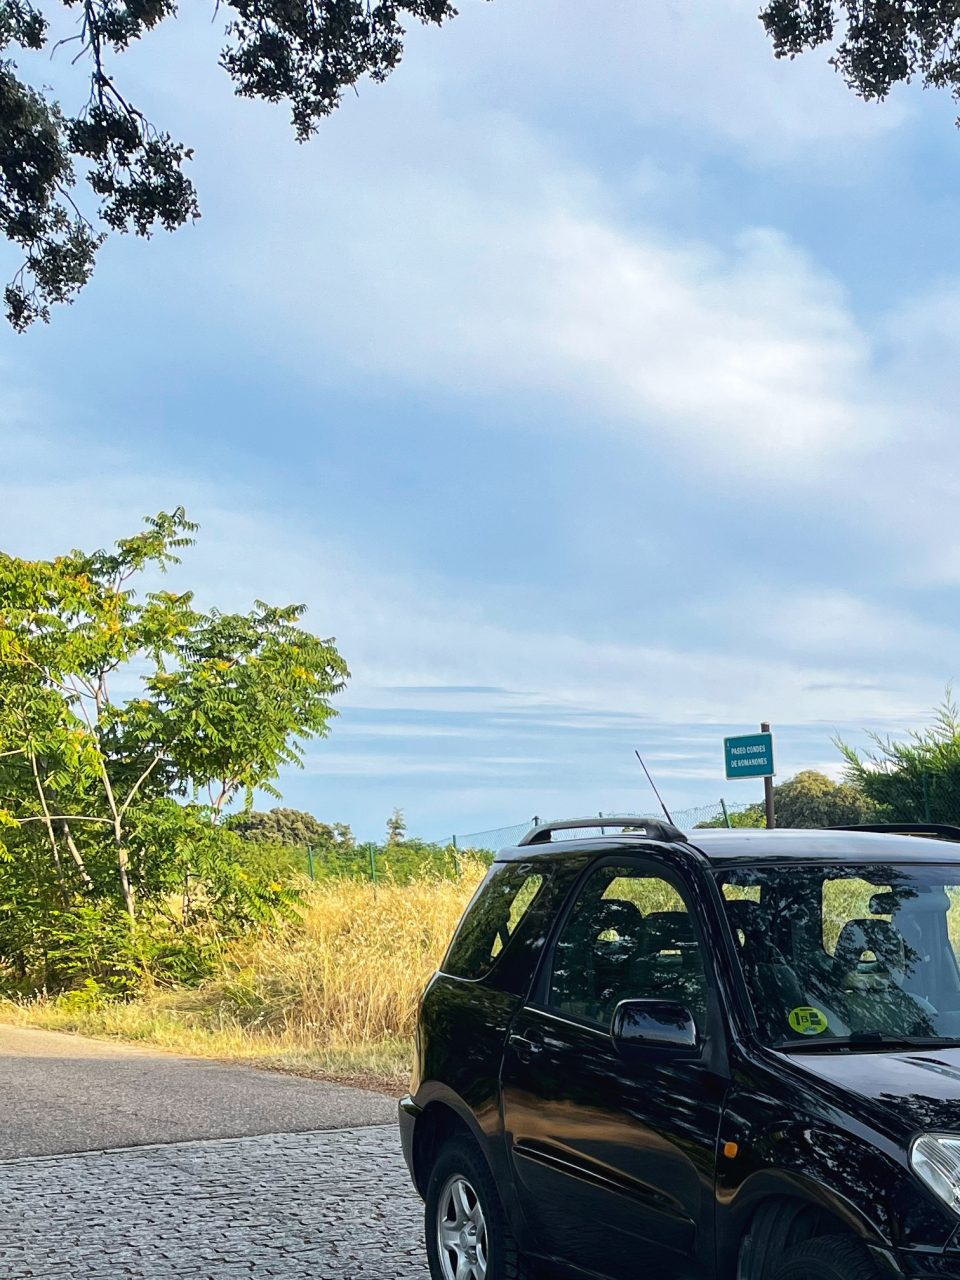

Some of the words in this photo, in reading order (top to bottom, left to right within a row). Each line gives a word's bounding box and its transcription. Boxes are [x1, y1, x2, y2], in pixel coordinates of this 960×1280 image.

[731, 746, 746, 755] PASEO
[746, 744, 766, 754] CONDES
[730, 760, 737, 768] DE
[737, 757, 768, 767] ROMANONES
